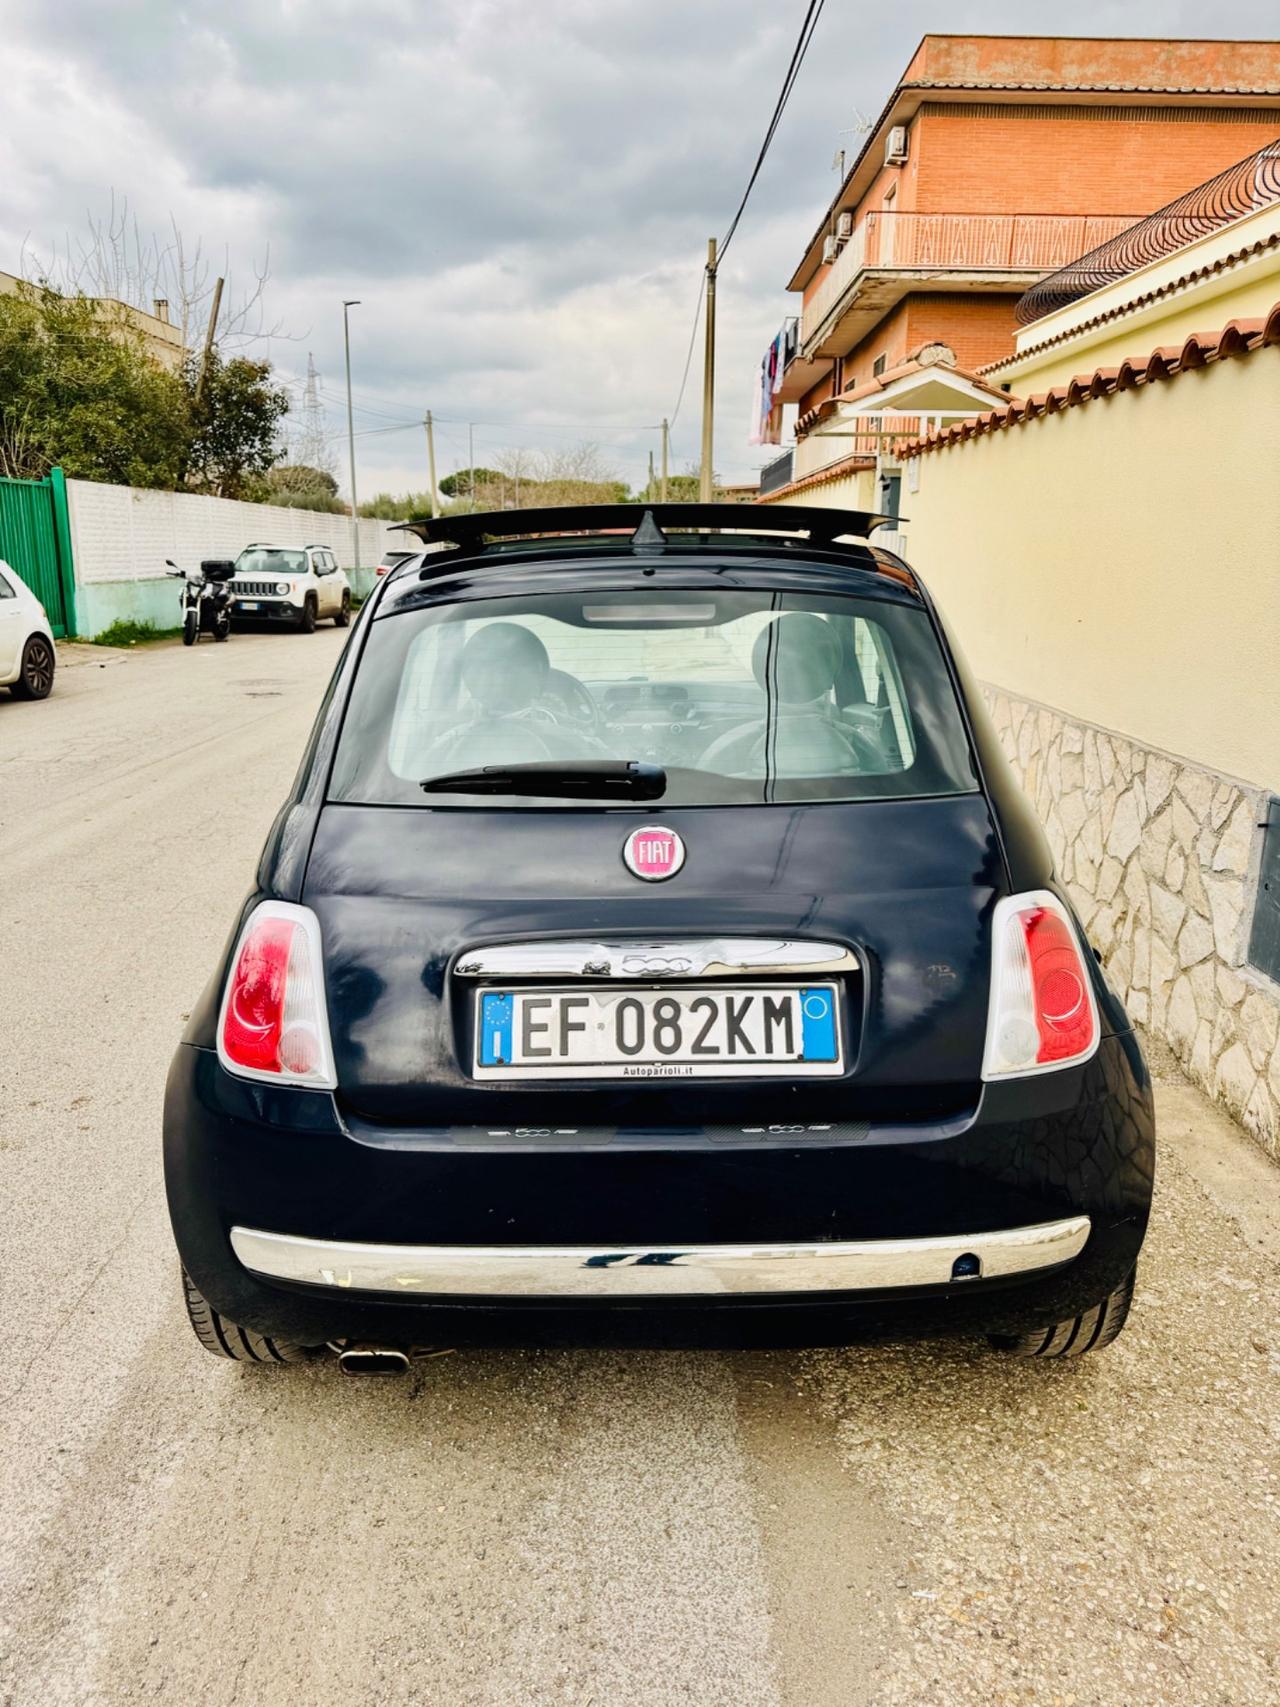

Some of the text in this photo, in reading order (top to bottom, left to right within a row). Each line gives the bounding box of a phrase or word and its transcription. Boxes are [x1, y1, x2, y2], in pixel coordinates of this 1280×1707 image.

[638, 840, 672, 864] FIAT
[622, 954, 693, 974] 500
[522, 997, 590, 1057] EF
[623, 1066, 694, 1077] Autoparioli.it
